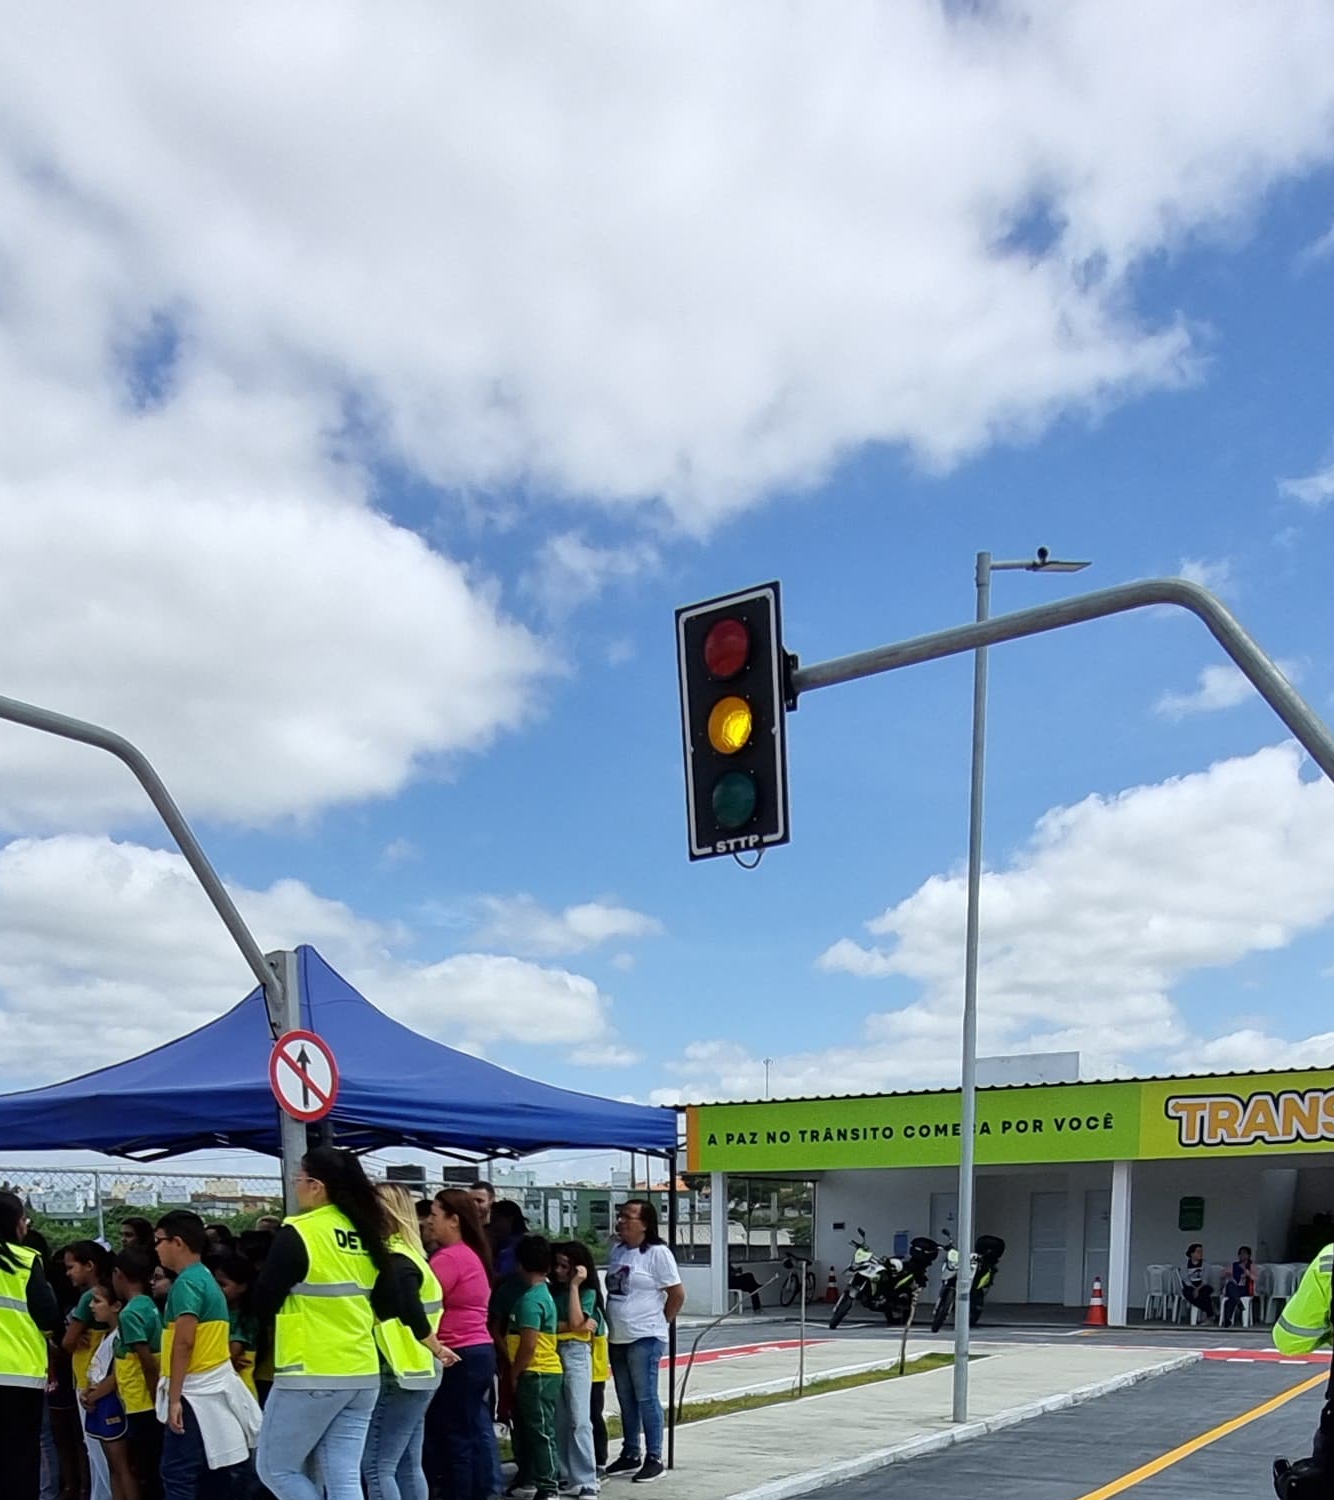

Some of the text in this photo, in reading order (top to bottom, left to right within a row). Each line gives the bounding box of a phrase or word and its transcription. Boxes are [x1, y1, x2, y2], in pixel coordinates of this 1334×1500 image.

[716, 834, 760, 853] STTP
[707, 1112, 1114, 1146] A PAZ NO TRÂNSITO COMEA POR VOCÊ
